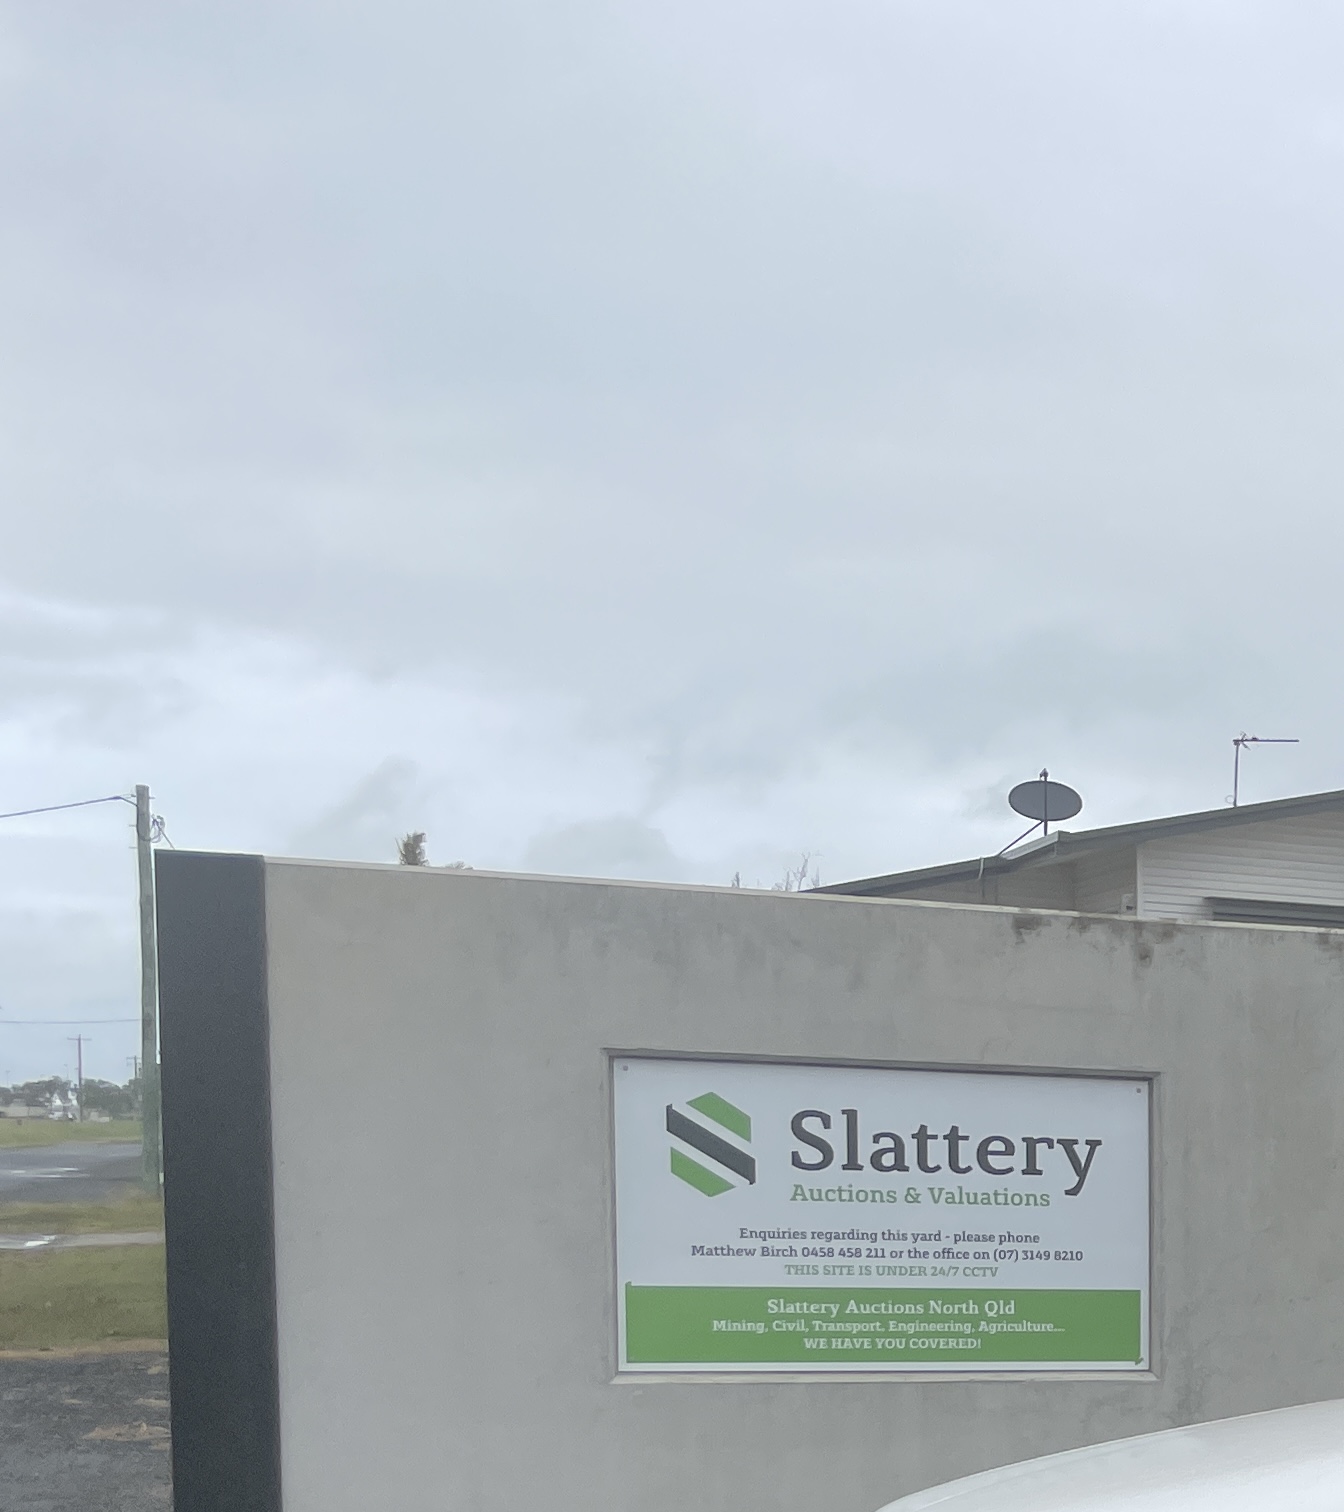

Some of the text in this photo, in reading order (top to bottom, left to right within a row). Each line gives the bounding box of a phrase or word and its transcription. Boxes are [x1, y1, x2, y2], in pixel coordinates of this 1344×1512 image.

[790, 1108, 1103, 1196] Slattery
[789, 1183, 1051, 1207] Auctions & Valuations
[739, 1227, 807, 1241] Enquiries
[810, 1228, 878, 1243] regarding
[881, 1229, 908, 1241] this
[911, 1230, 942, 1244] yard
[953, 1231, 996, 1245] please
[998, 1231, 1040, 1245] phone
[691, 1244, 1084, 1263] Matthew Birch 0458 458 211 or the office on (07) 3149 8210
[784, 1264, 999, 1278] THIS SITE IS UNDER 24/7 CCTV
[767, 1298, 1015, 1318] Slattery Auctions North Qld
[712, 1319, 769, 1334] Mining,
[772, 1319, 810, 1333] Civil,
[803, 1337, 982, 1349] WE HAVE YOU COVERED!
